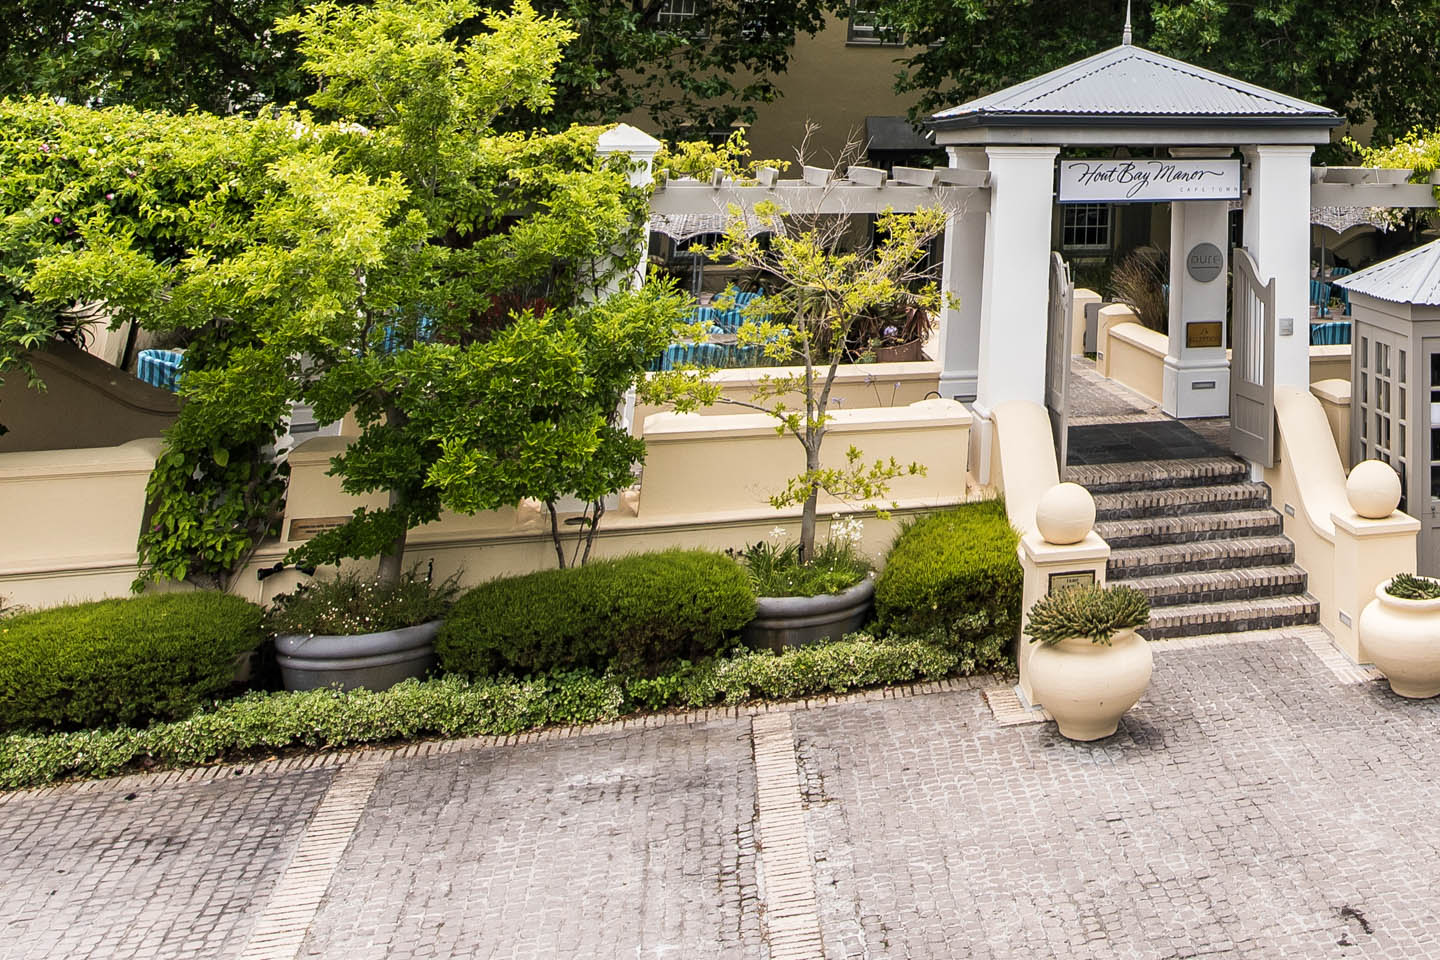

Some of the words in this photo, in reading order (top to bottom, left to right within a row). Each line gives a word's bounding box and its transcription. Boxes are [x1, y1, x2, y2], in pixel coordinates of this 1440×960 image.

[1068, 163, 1119, 185] Hout
[1117, 162, 1150, 198] Bay
[1147, 161, 1224, 183] Manor
[1191, 255, 1221, 265] pure
